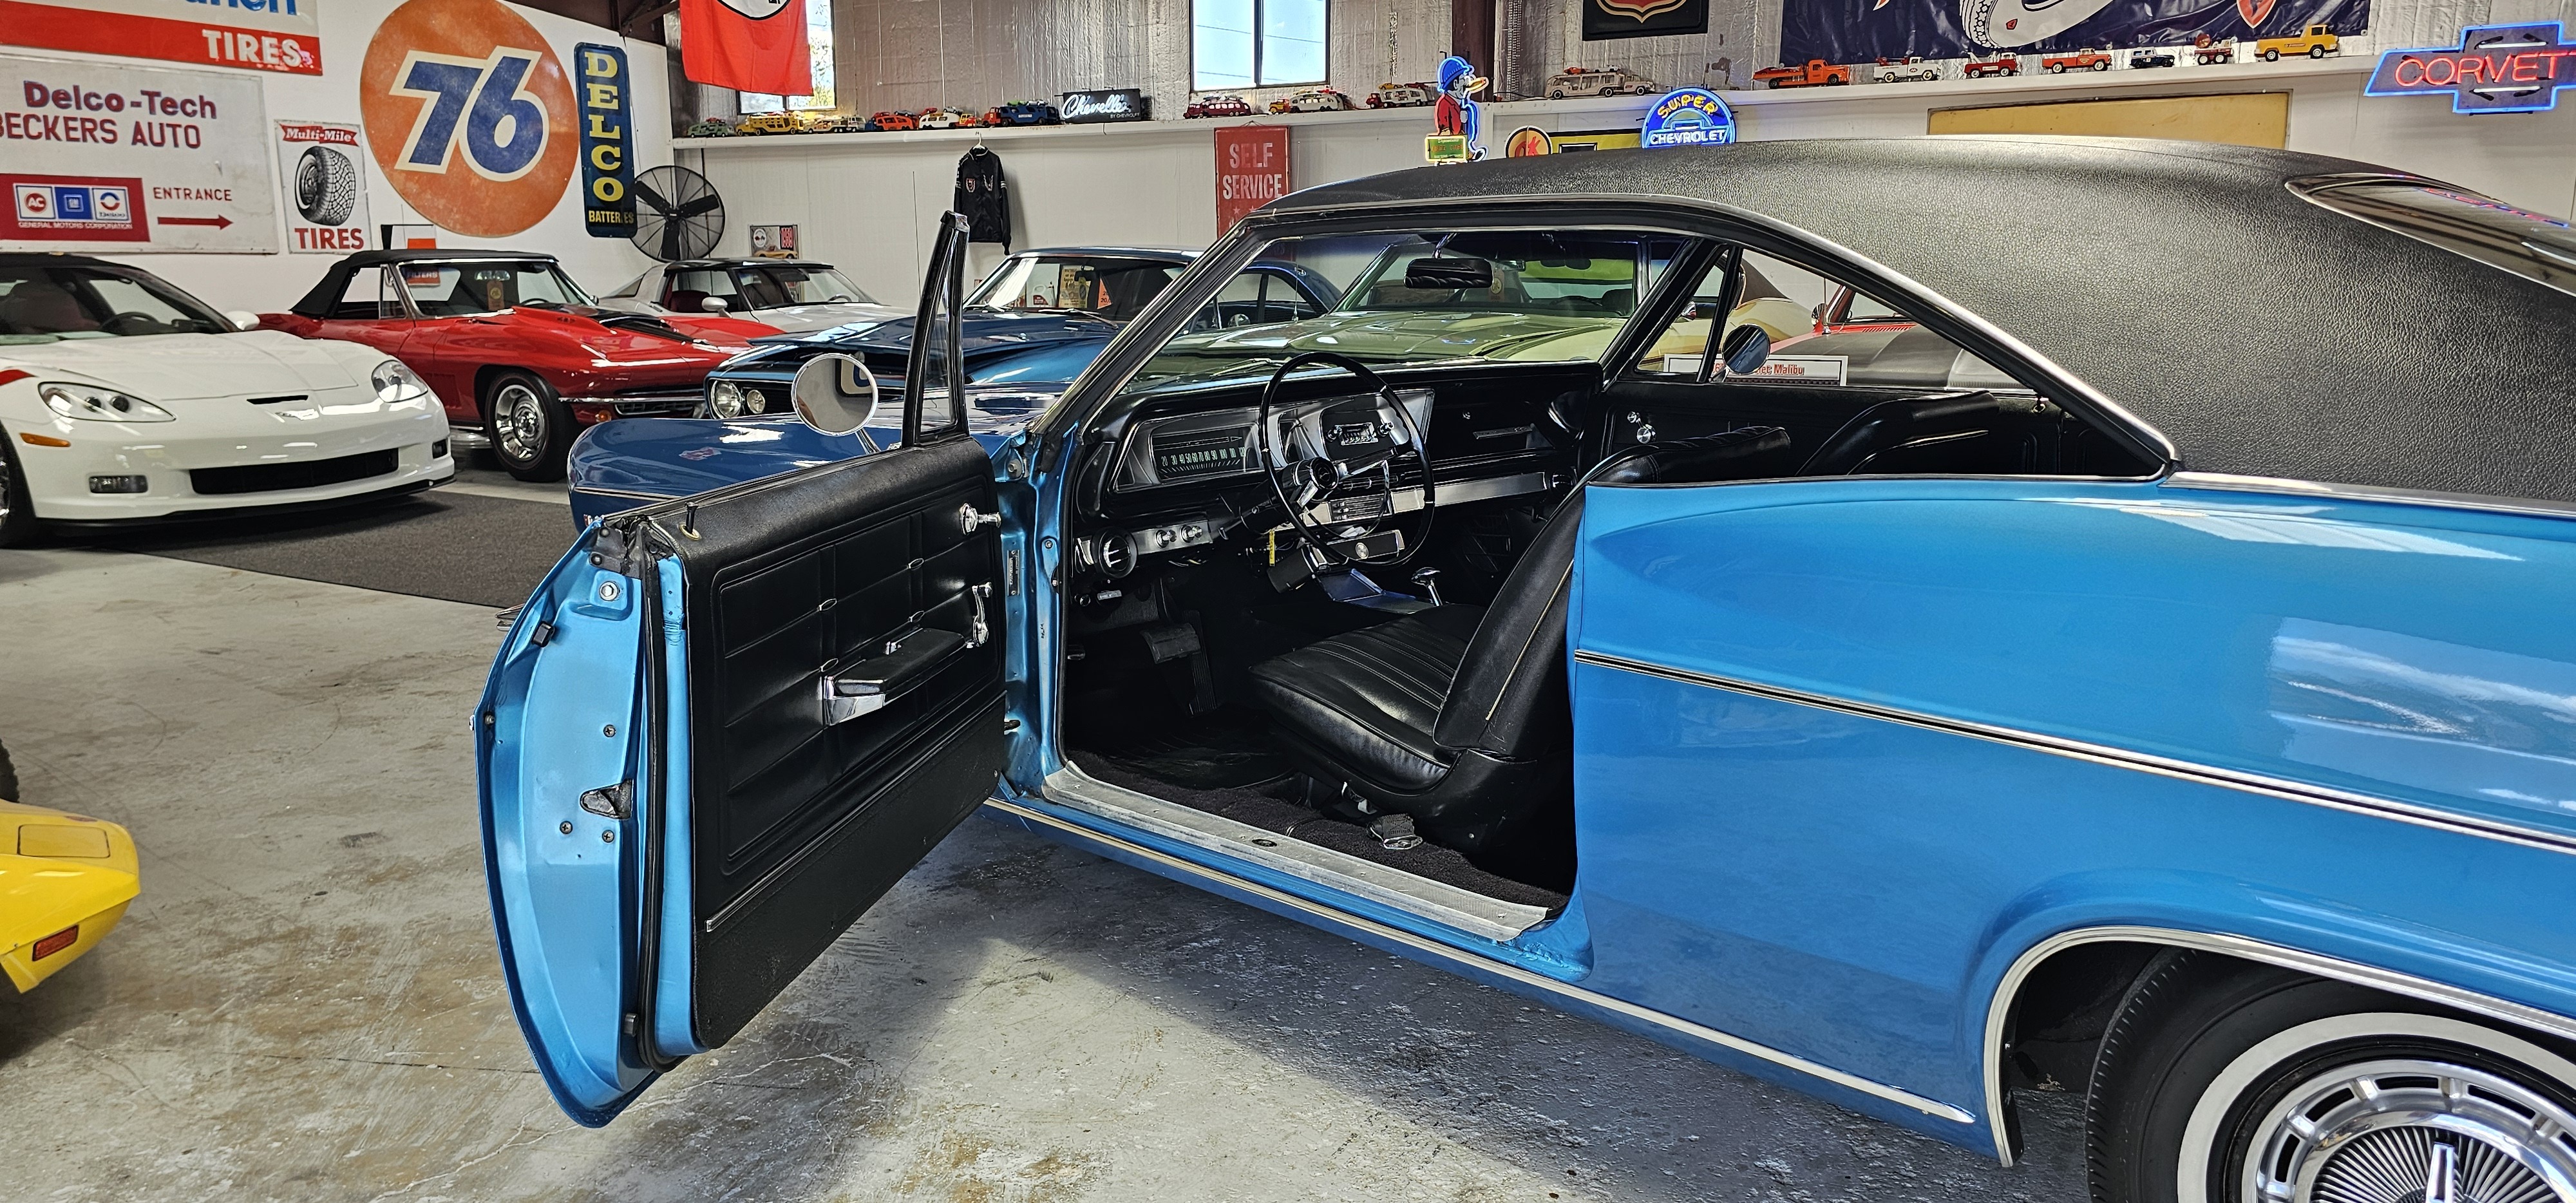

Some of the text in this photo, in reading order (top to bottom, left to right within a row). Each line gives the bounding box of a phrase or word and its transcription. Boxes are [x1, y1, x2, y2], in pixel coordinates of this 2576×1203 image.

[202, 29, 303, 67] TIRES
[2394, 50, 2576, 87] CORVET
[393, 49, 547, 180] 76
[1062, 94, 1130, 119] Chevelle
[1657, 93, 1718, 119] SUPER
[131, 120, 201, 149] AUTO
[285, 128, 352, 142] Multi-Mile
[584, 52, 625, 204] DELCO
[1649, 129, 1725, 145] CHEVROLET
[1229, 142, 1273, 169] SELF
[153, 187, 232, 202] ENTRANCE
[1222, 173, 1283, 200] SERVICE
[28, 197, 44, 208] AC
[294, 228, 364, 249] TIRES
[1774, 364, 1804, 375] Malibu
[1161, 456, 1168, 466] 20
[1171, 455, 1178, 466] 30
[1179, 453, 1186, 464] 40
[1185, 453, 1191, 464] 50
[1191, 452, 1198, 463] 60
[1198, 451, 1204, 462] 70
[1204, 451, 1211, 461] 80
[1211, 450, 1218, 460] 90
